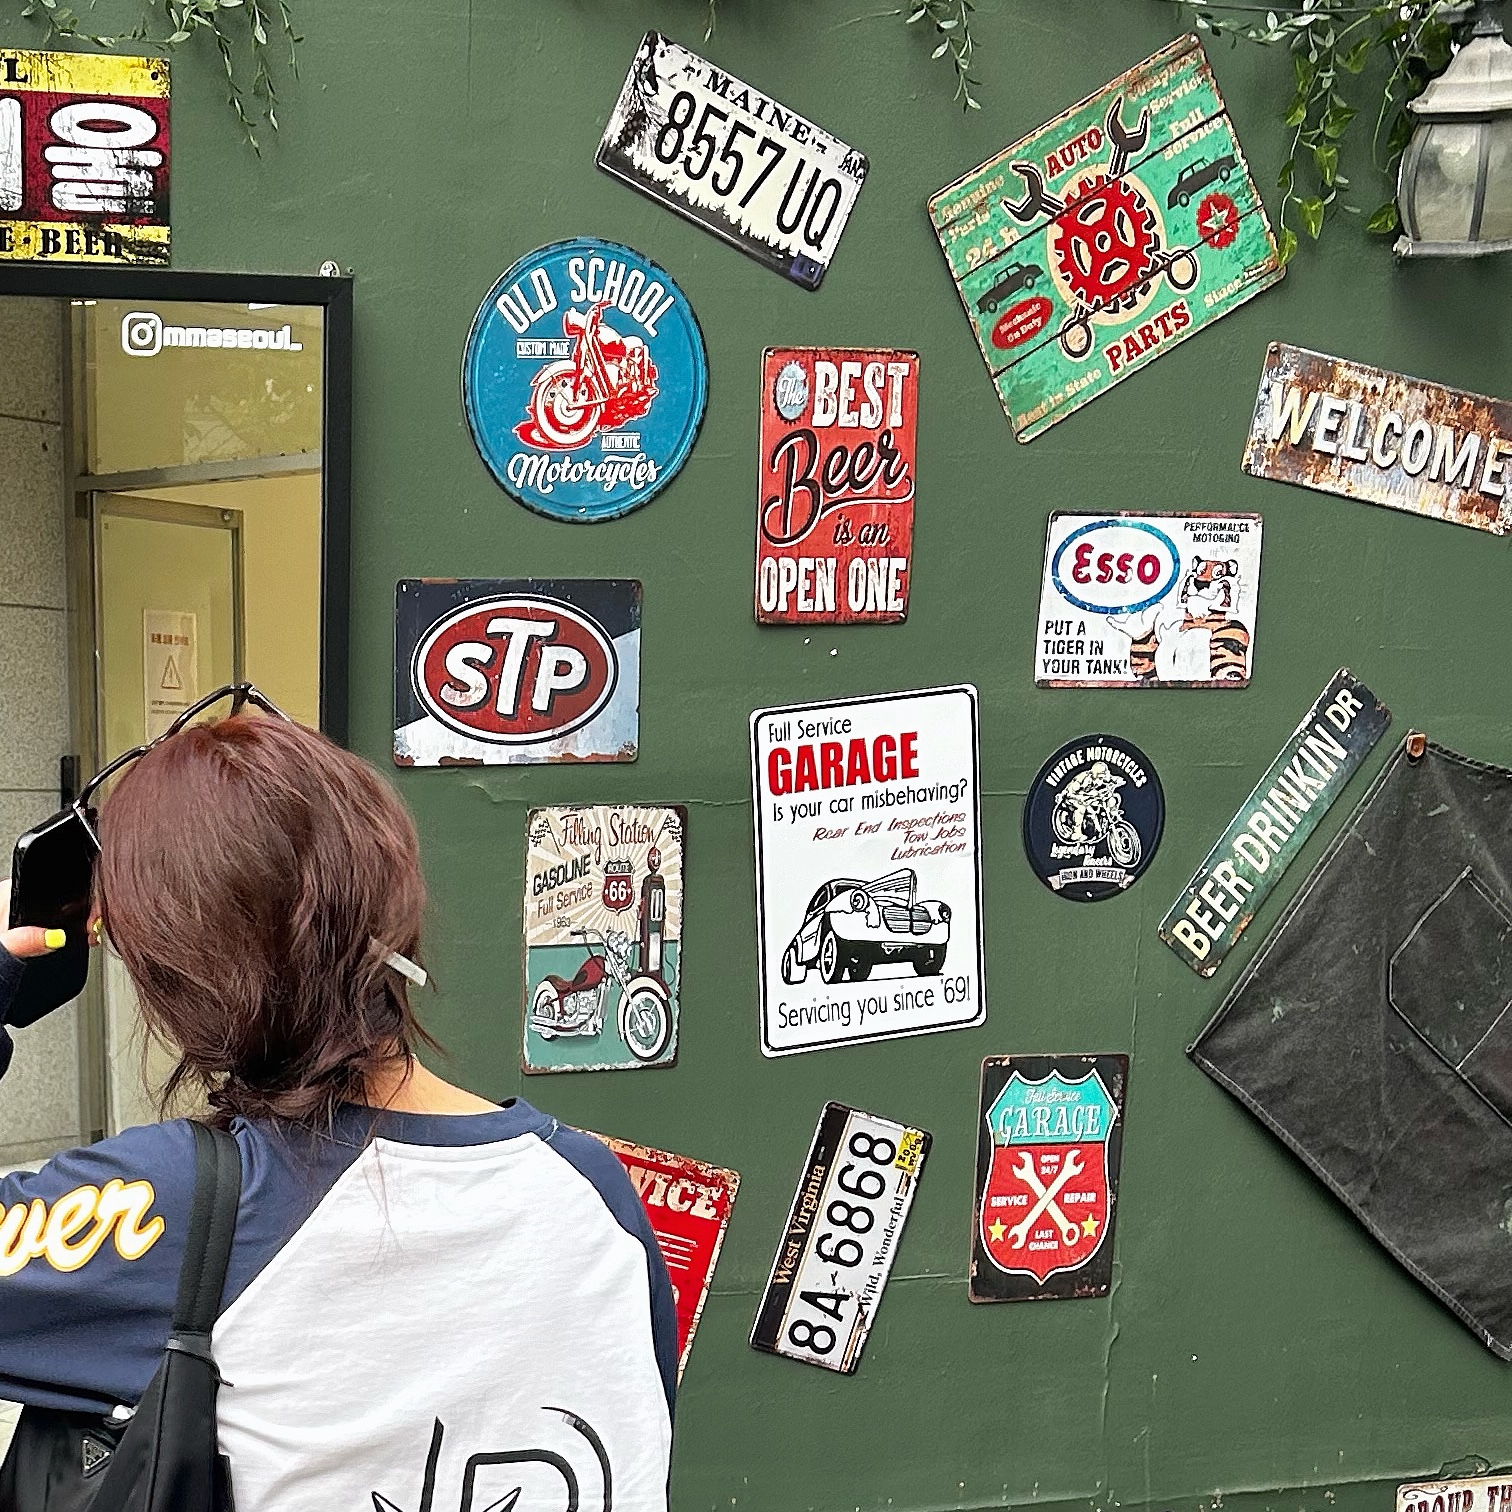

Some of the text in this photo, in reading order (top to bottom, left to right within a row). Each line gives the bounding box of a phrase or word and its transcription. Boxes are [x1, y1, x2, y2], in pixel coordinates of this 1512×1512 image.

[702, 67, 810, 147] MAINE
[654, 89, 787, 209] 8557
[1044, 125, 1104, 181] AUTO
[496, 256, 676, 338] OLD SCHOOL
[516, 341, 571, 356] CUSTOM MADE
[1105, 302, 1191, 373] PARTS
[778, 361, 910, 430] The BEST
[1270, 379, 1512, 497] WELCOME
[507, 452, 664, 495] Motorcycles
[760, 428, 916, 548] Beer
[832, 513, 891, 548] is an
[760, 556, 908, 613] OPEN ONE
[1043, 639, 1104, 656] TIGER IN
[1044, 620, 1087, 636] PUT A
[438, 616, 590, 717] STP
[1041, 659, 1129, 675] YOUR TANK!
[769, 717, 852, 743] Full Service
[767, 731, 920, 797] GARAGE
[1045, 746, 1149, 789] VINTAGE MOTORCYCLES
[773, 778, 969, 825] Is your car misbehaving?
[1171, 687, 1365, 961] BEER DRINKIN DR
[532, 854, 592, 897] GASOLINE
[608, 880, 627, 902] 66
[537, 881, 594, 919] Full Service
[778, 995, 851, 1029] Servicing
[856, 996, 888, 1025] you
[893, 984, 935, 1011] since
[998, 1103, 1102, 1149] GARAGE
[625, 1164, 724, 1220] VICE
[990, 1194, 1029, 1208] SERVICE
[1062, 1192, 1097, 1205] REPAIR
[772, 1163, 827, 1286] West Virginia
[872, 1196, 906, 1269] Wonderful
[1034, 1230, 1054, 1240] LAST
